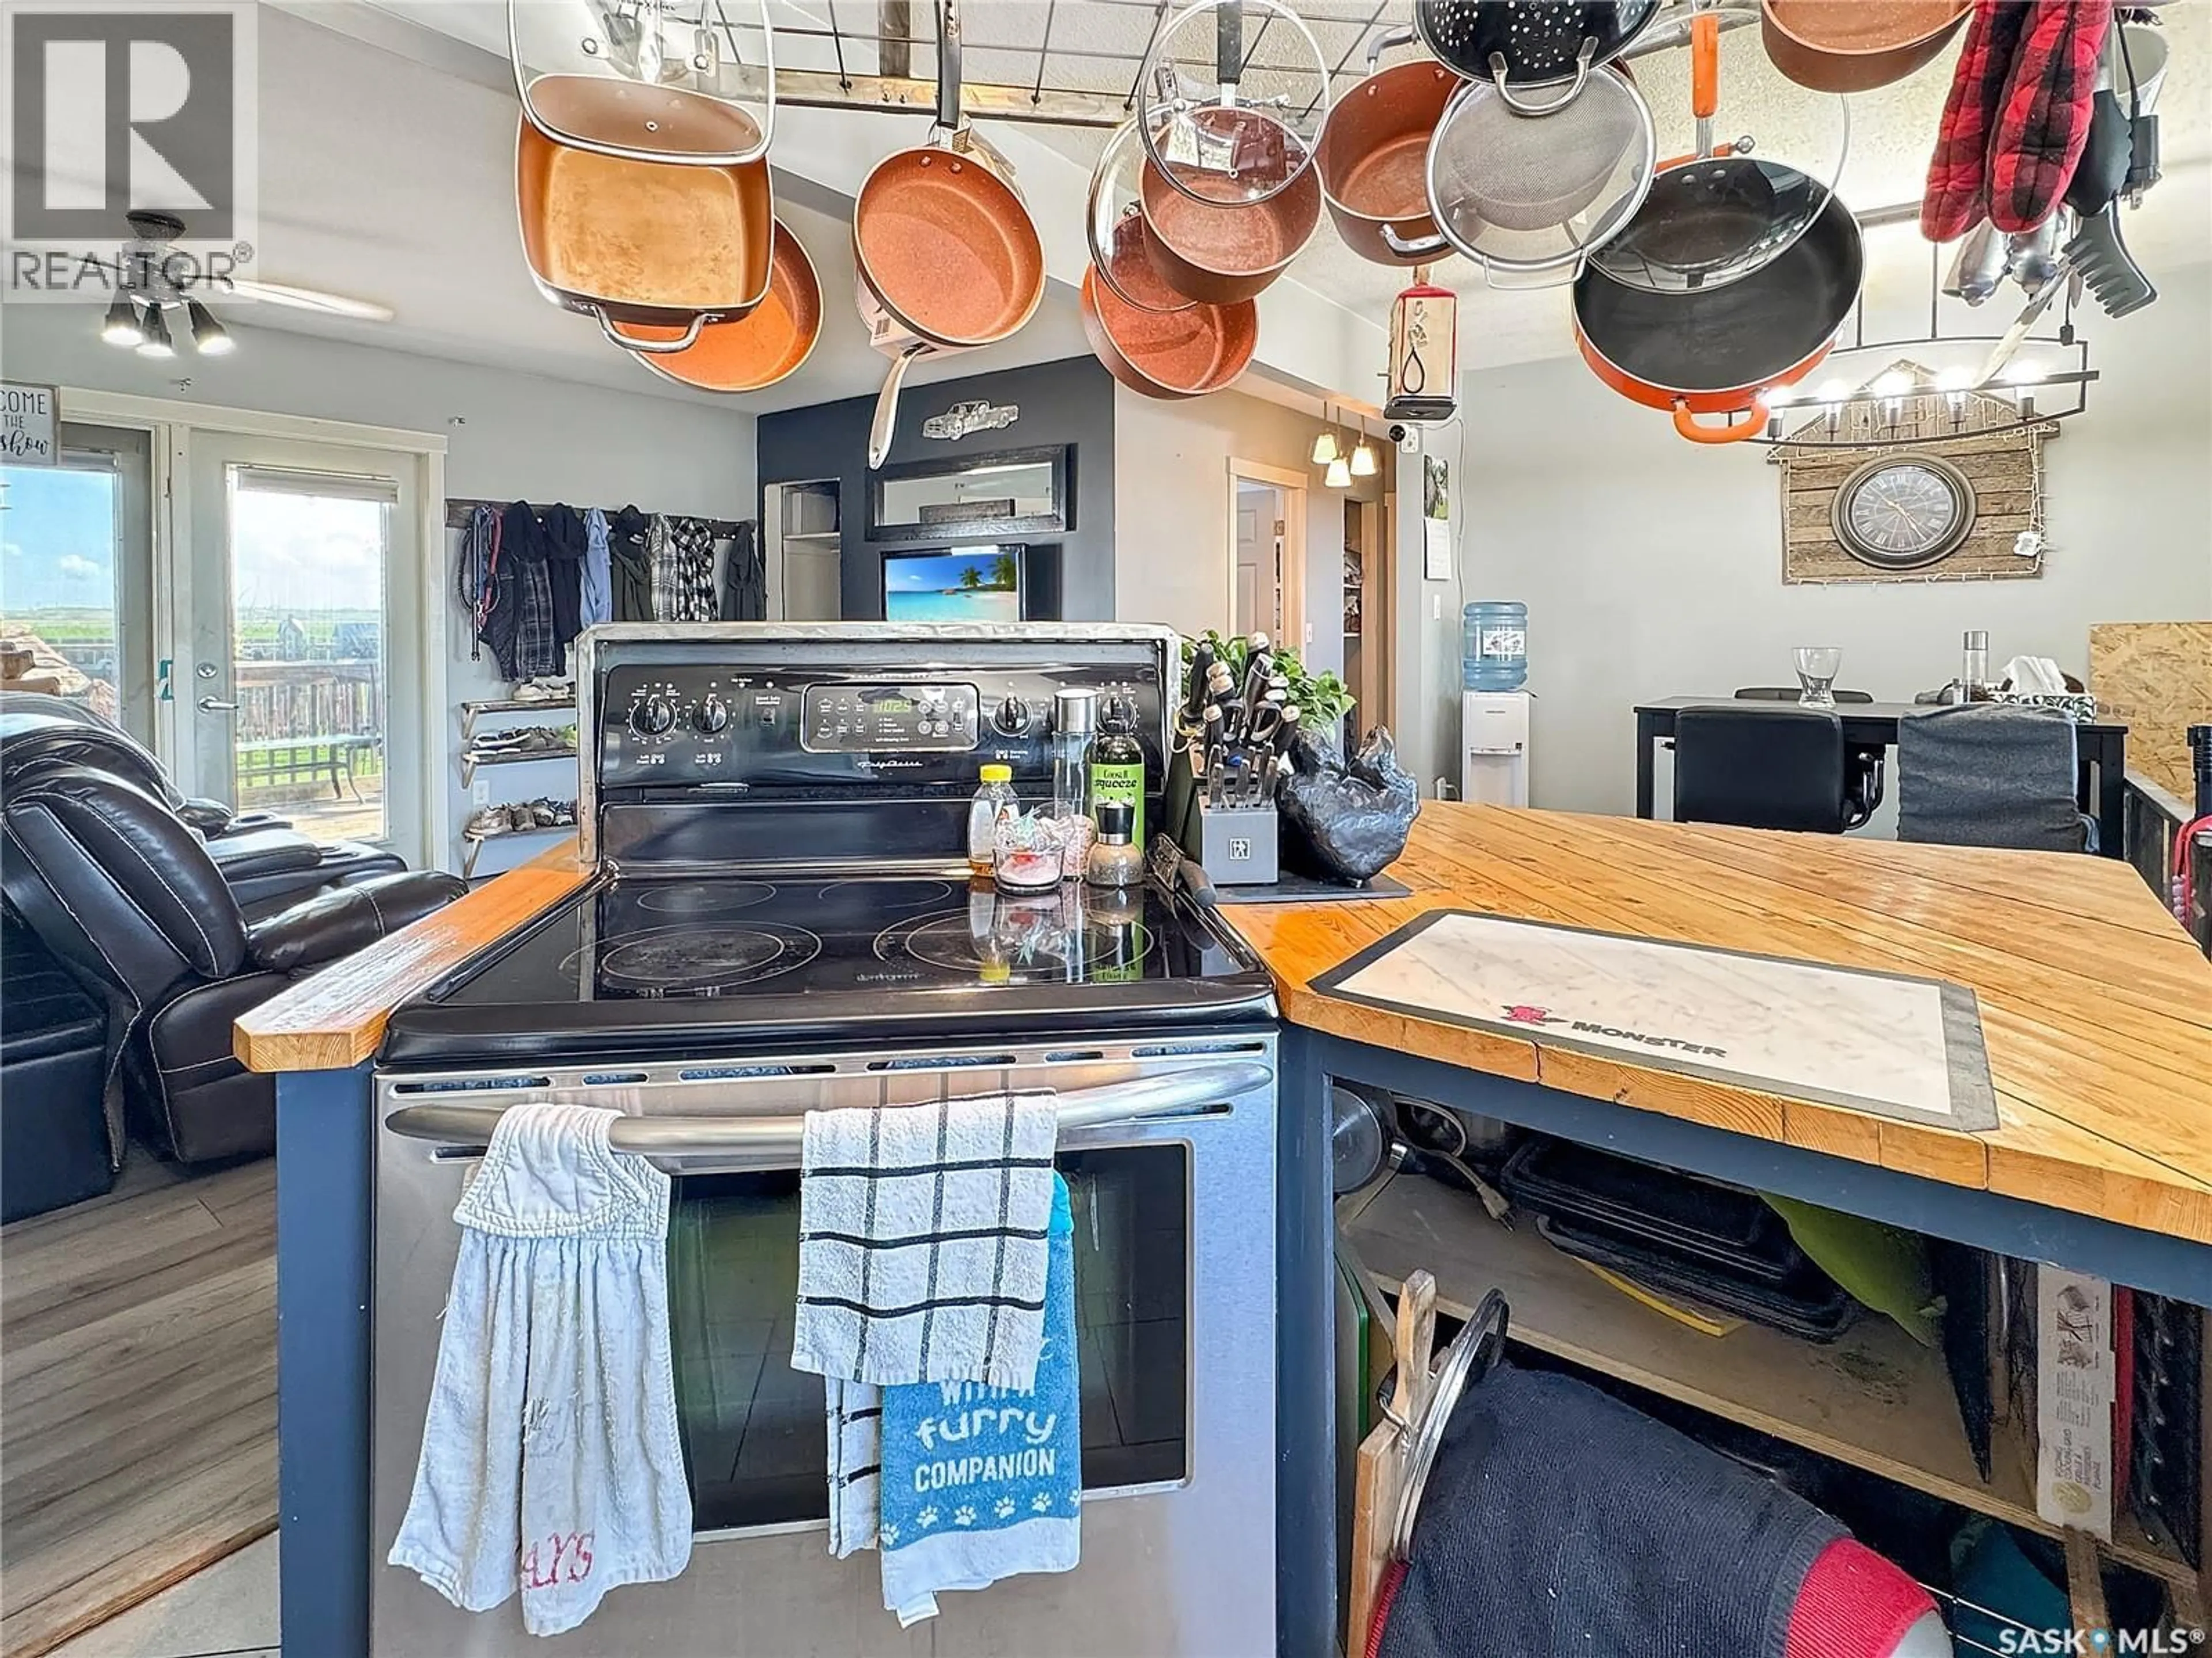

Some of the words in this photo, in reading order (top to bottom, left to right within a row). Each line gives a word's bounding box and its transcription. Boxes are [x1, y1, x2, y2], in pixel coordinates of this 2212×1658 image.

[3, 415, 25, 429] THE
[1571, 1020, 1727, 1057] MONSTER
[915, 1407, 1058, 1451] furry
[915, 1447, 1055, 1493] COMPANION
